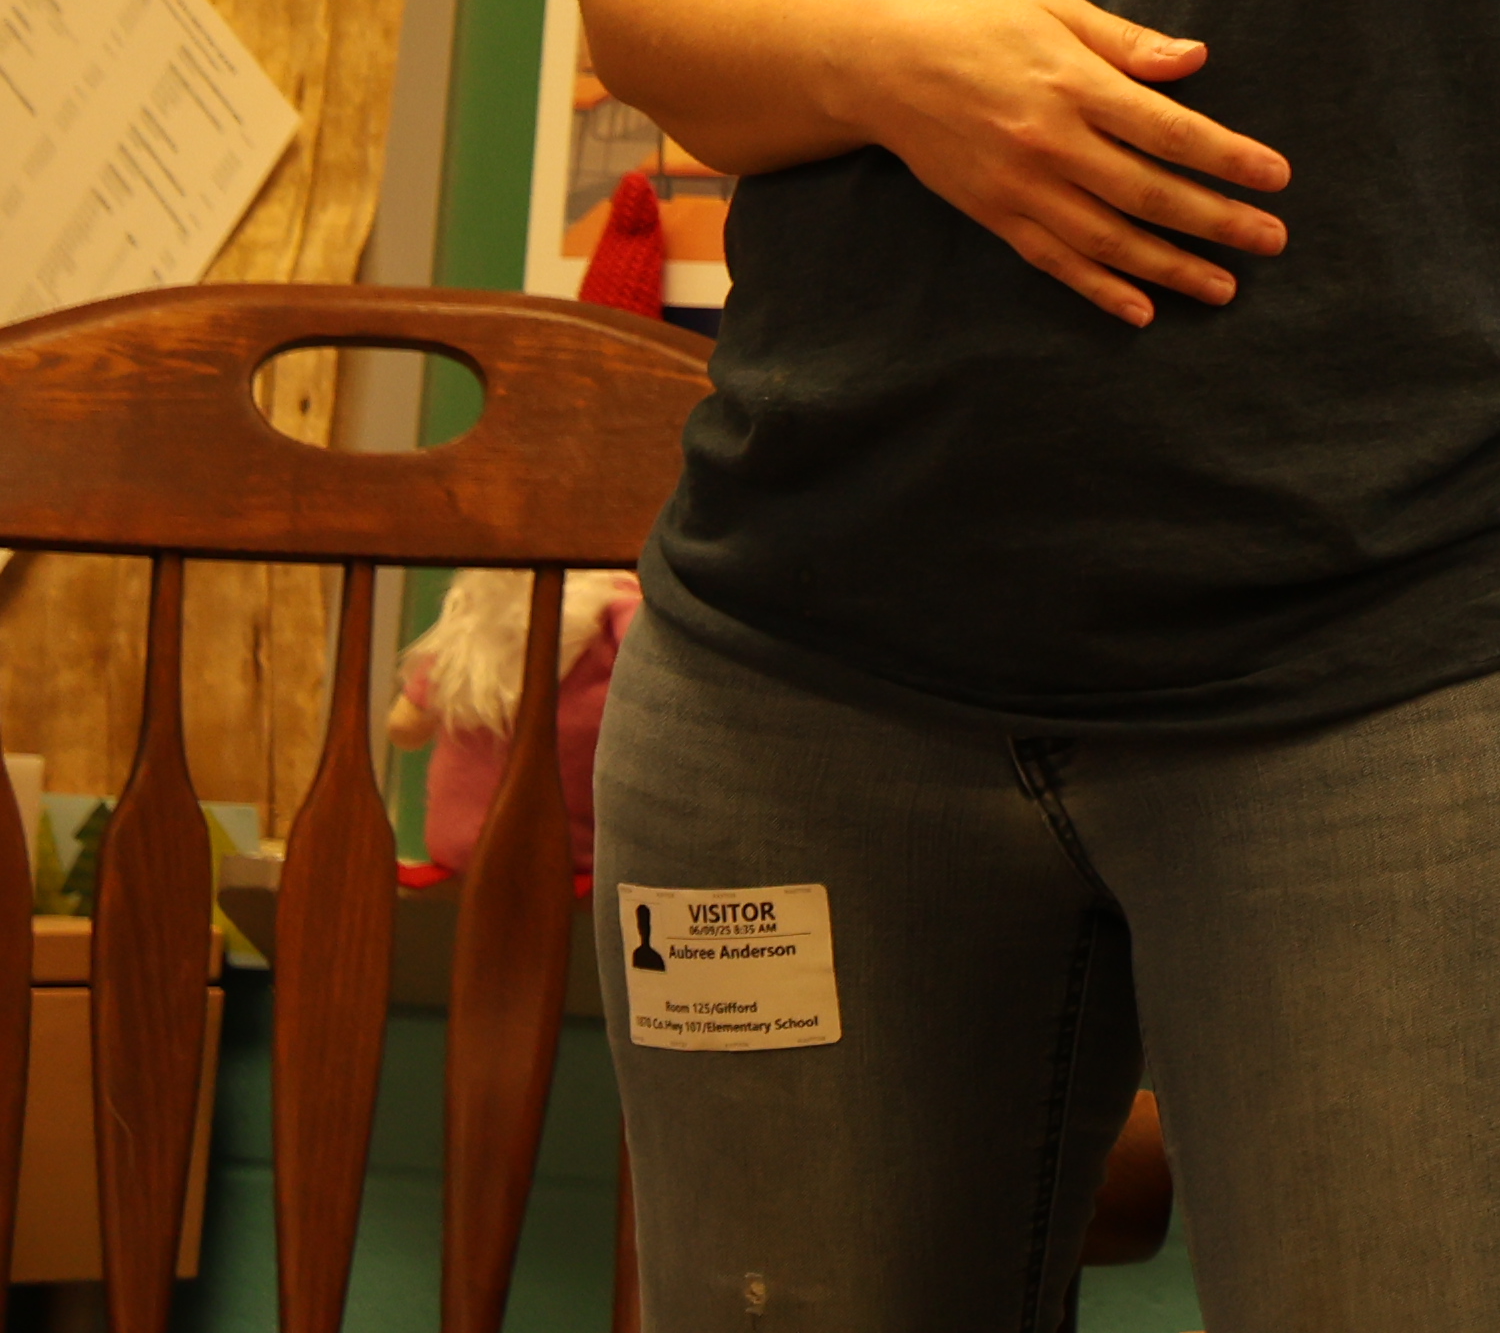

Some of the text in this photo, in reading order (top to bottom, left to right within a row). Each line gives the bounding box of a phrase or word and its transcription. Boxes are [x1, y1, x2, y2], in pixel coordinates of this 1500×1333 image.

[688, 902, 776, 923] VISITOR
[758, 923, 776, 933] AM
[669, 943, 796, 959] Aubree Anderson
[775, 1016, 818, 1030] School
